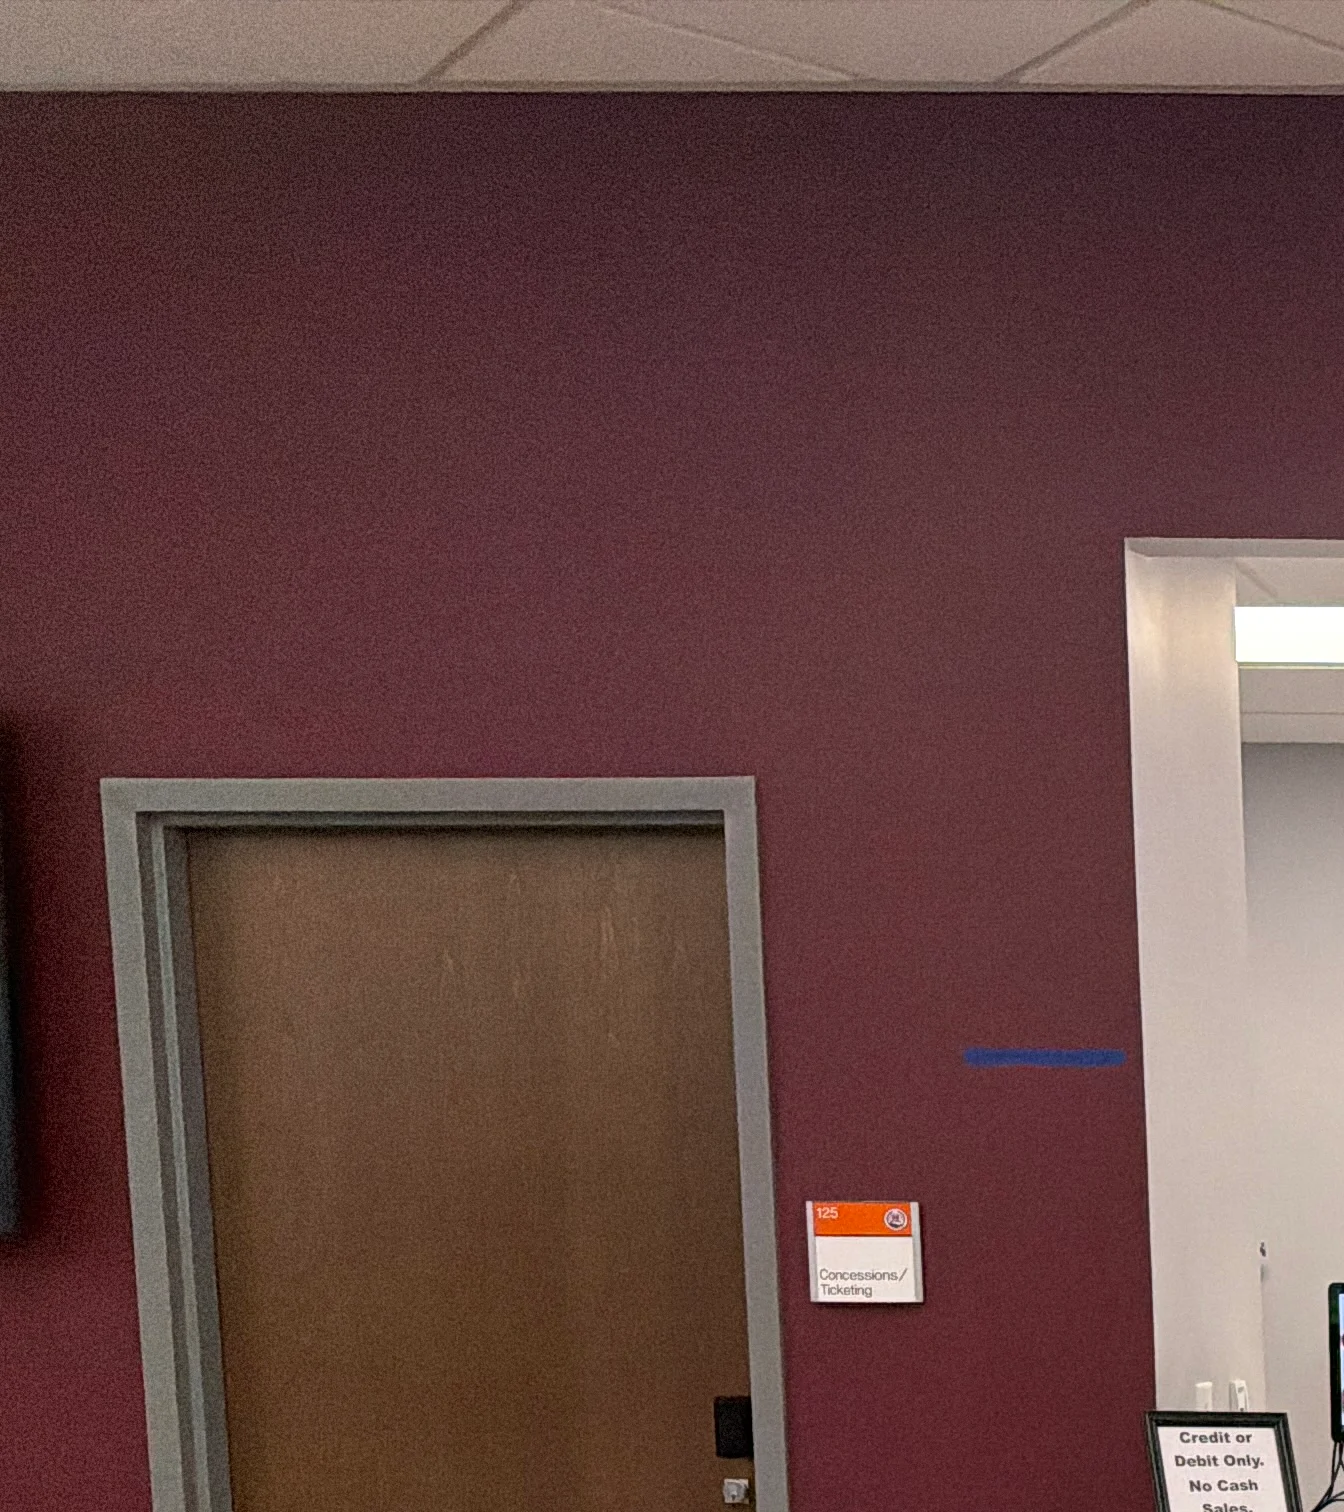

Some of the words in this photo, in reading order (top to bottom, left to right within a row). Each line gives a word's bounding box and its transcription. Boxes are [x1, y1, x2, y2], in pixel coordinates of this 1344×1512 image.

[816, 1207, 838, 1219] 125
[819, 1268, 908, 1281] Concessions/
[820, 1284, 873, 1298] Ticketing
[1179, 1432, 1231, 1444] Credit
[1236, 1433, 1252, 1444] or
[1174, 1455, 1219, 1467] Debit
[1223, 1454, 1264, 1469] Only.
[1189, 1480, 1212, 1492] No
[1217, 1479, 1259, 1491] Cash
